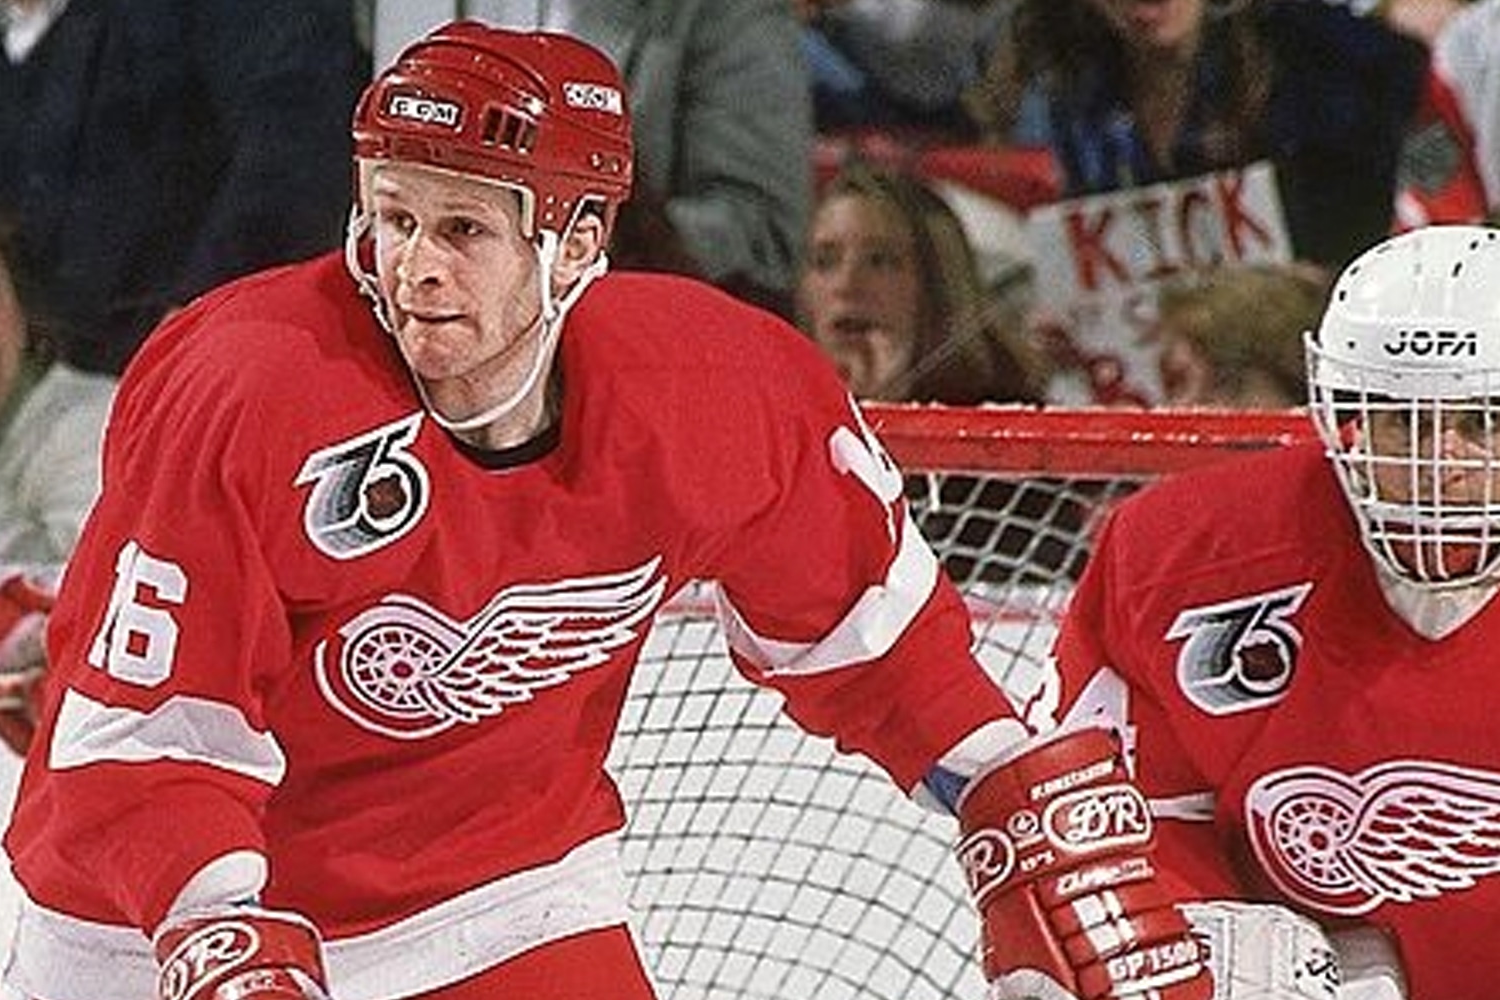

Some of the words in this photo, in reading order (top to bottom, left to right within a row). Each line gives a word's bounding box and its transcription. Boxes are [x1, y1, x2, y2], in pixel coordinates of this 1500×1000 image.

[1066, 172, 1272, 291] KICK
[1383, 330, 1478, 356] JOFA
[292, 410, 431, 560] 75
[88, 539, 188, 688] 16
[1164, 581, 1314, 716] 75
